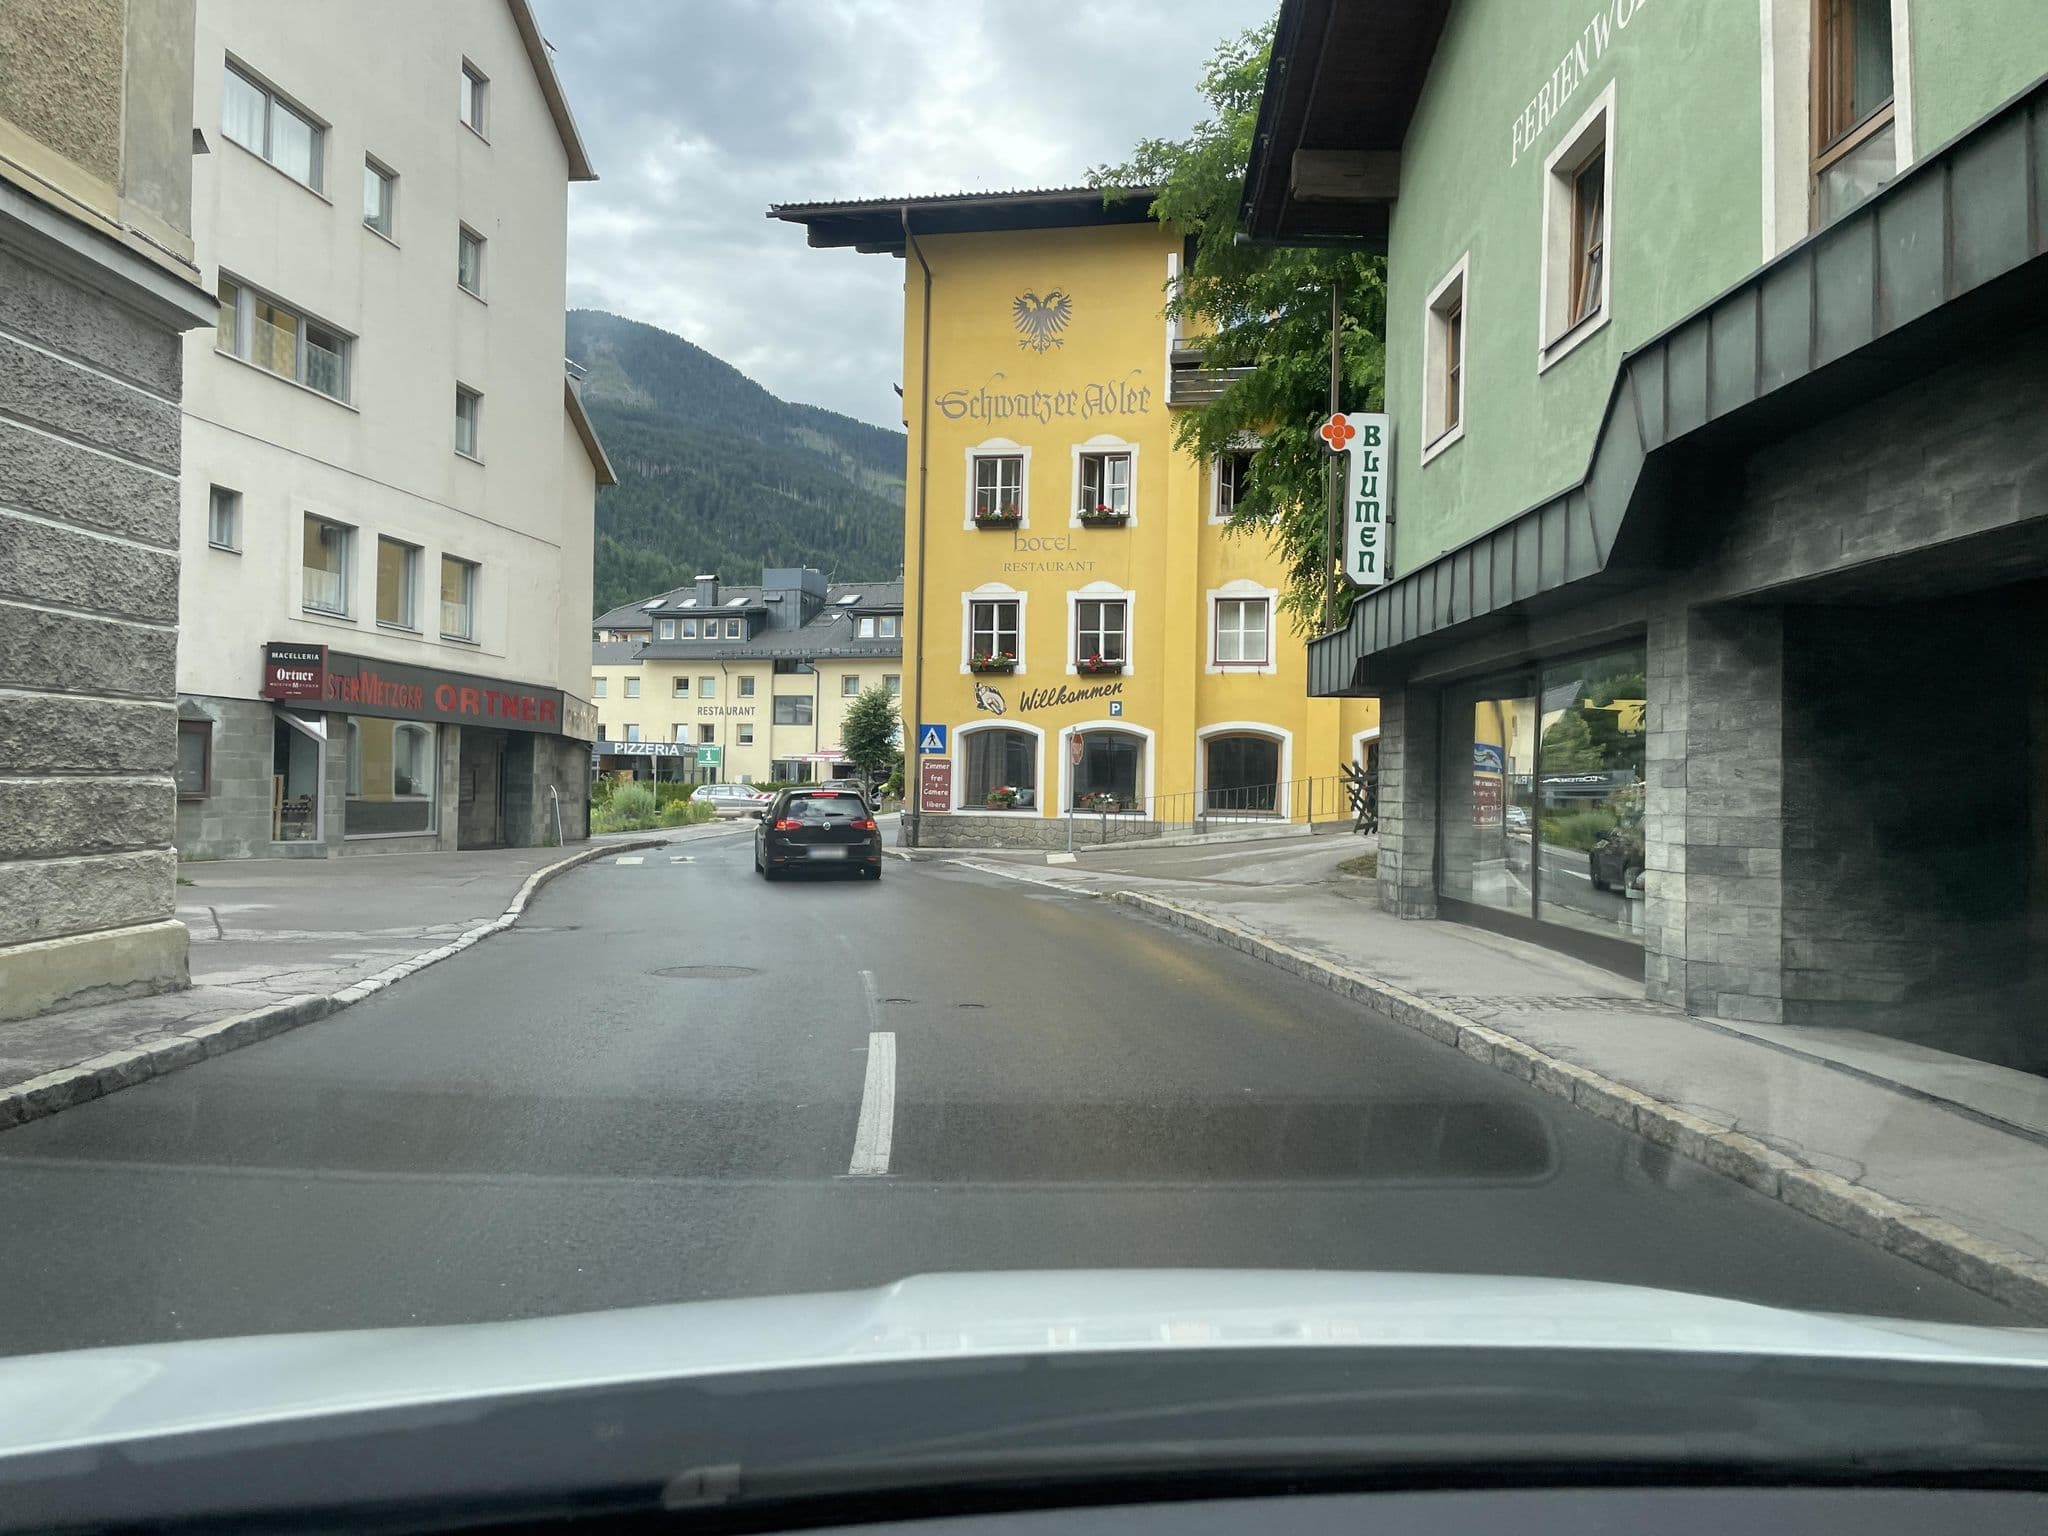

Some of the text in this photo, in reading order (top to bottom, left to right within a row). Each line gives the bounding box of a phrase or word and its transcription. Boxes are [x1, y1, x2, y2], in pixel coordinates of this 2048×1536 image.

[1511, 0, 1646, 168] FERIENWO
[935, 369, 1151, 426] Schwarzer Adler
[1355, 425, 1381, 573] BLUMEN
[1003, 561, 1096, 572] RESTAURANT
[271, 652, 320, 660] MACELLERIA
[276, 668, 314, 681] Ortner
[434, 684, 556, 722] ORTNER
[1019, 682, 1123, 713] Willkommen
[697, 706, 756, 716] RESTAURANT
[930, 774, 943, 782] frei
